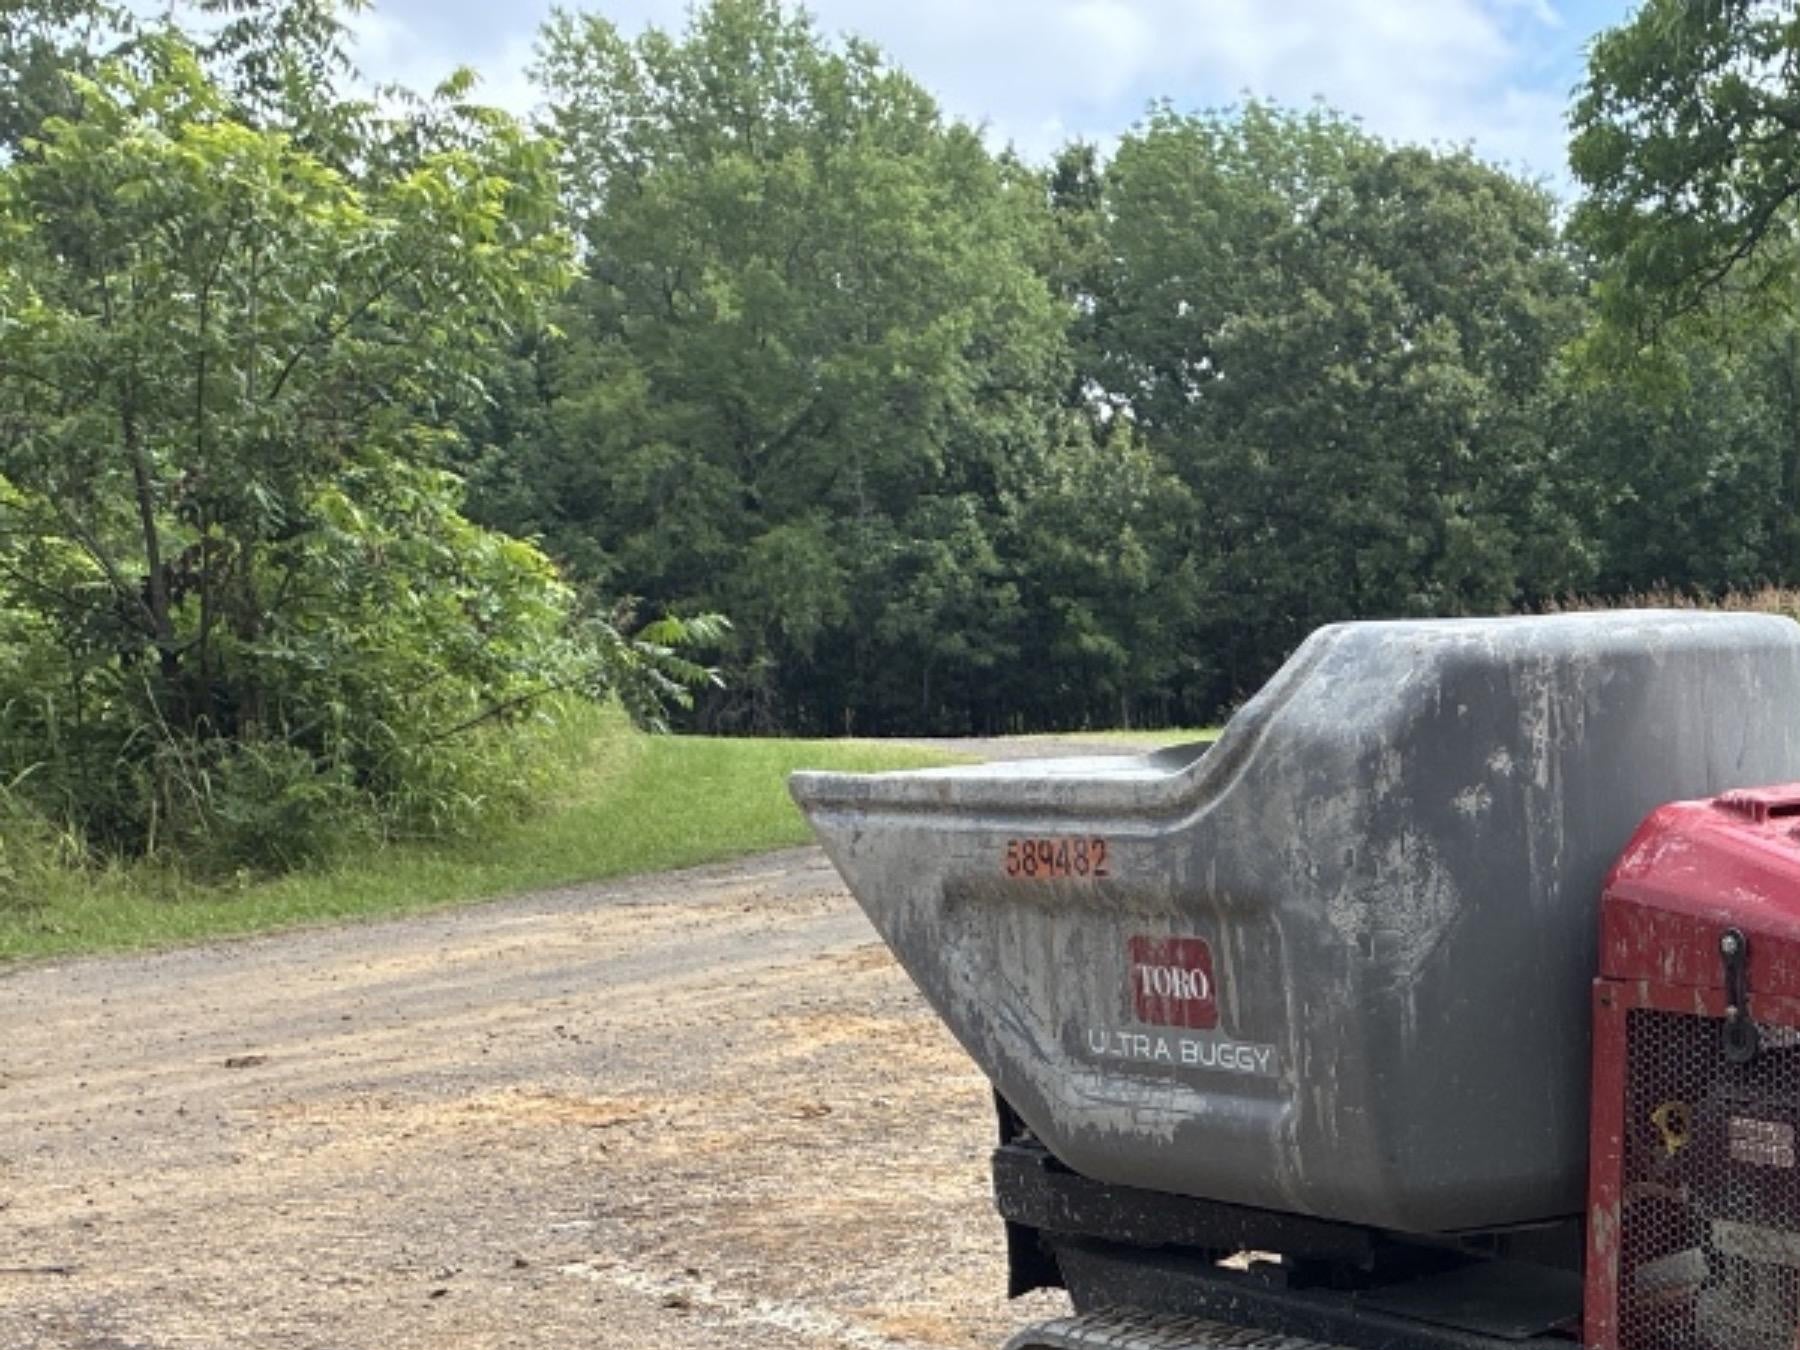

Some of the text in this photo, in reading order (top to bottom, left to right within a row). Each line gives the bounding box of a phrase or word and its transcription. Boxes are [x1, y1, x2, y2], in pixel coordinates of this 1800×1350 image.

[1006, 838, 1109, 877] 589482
[1136, 963, 1210, 1001] TORO
[1088, 1028, 1271, 1073] ULTRA BUGGY
